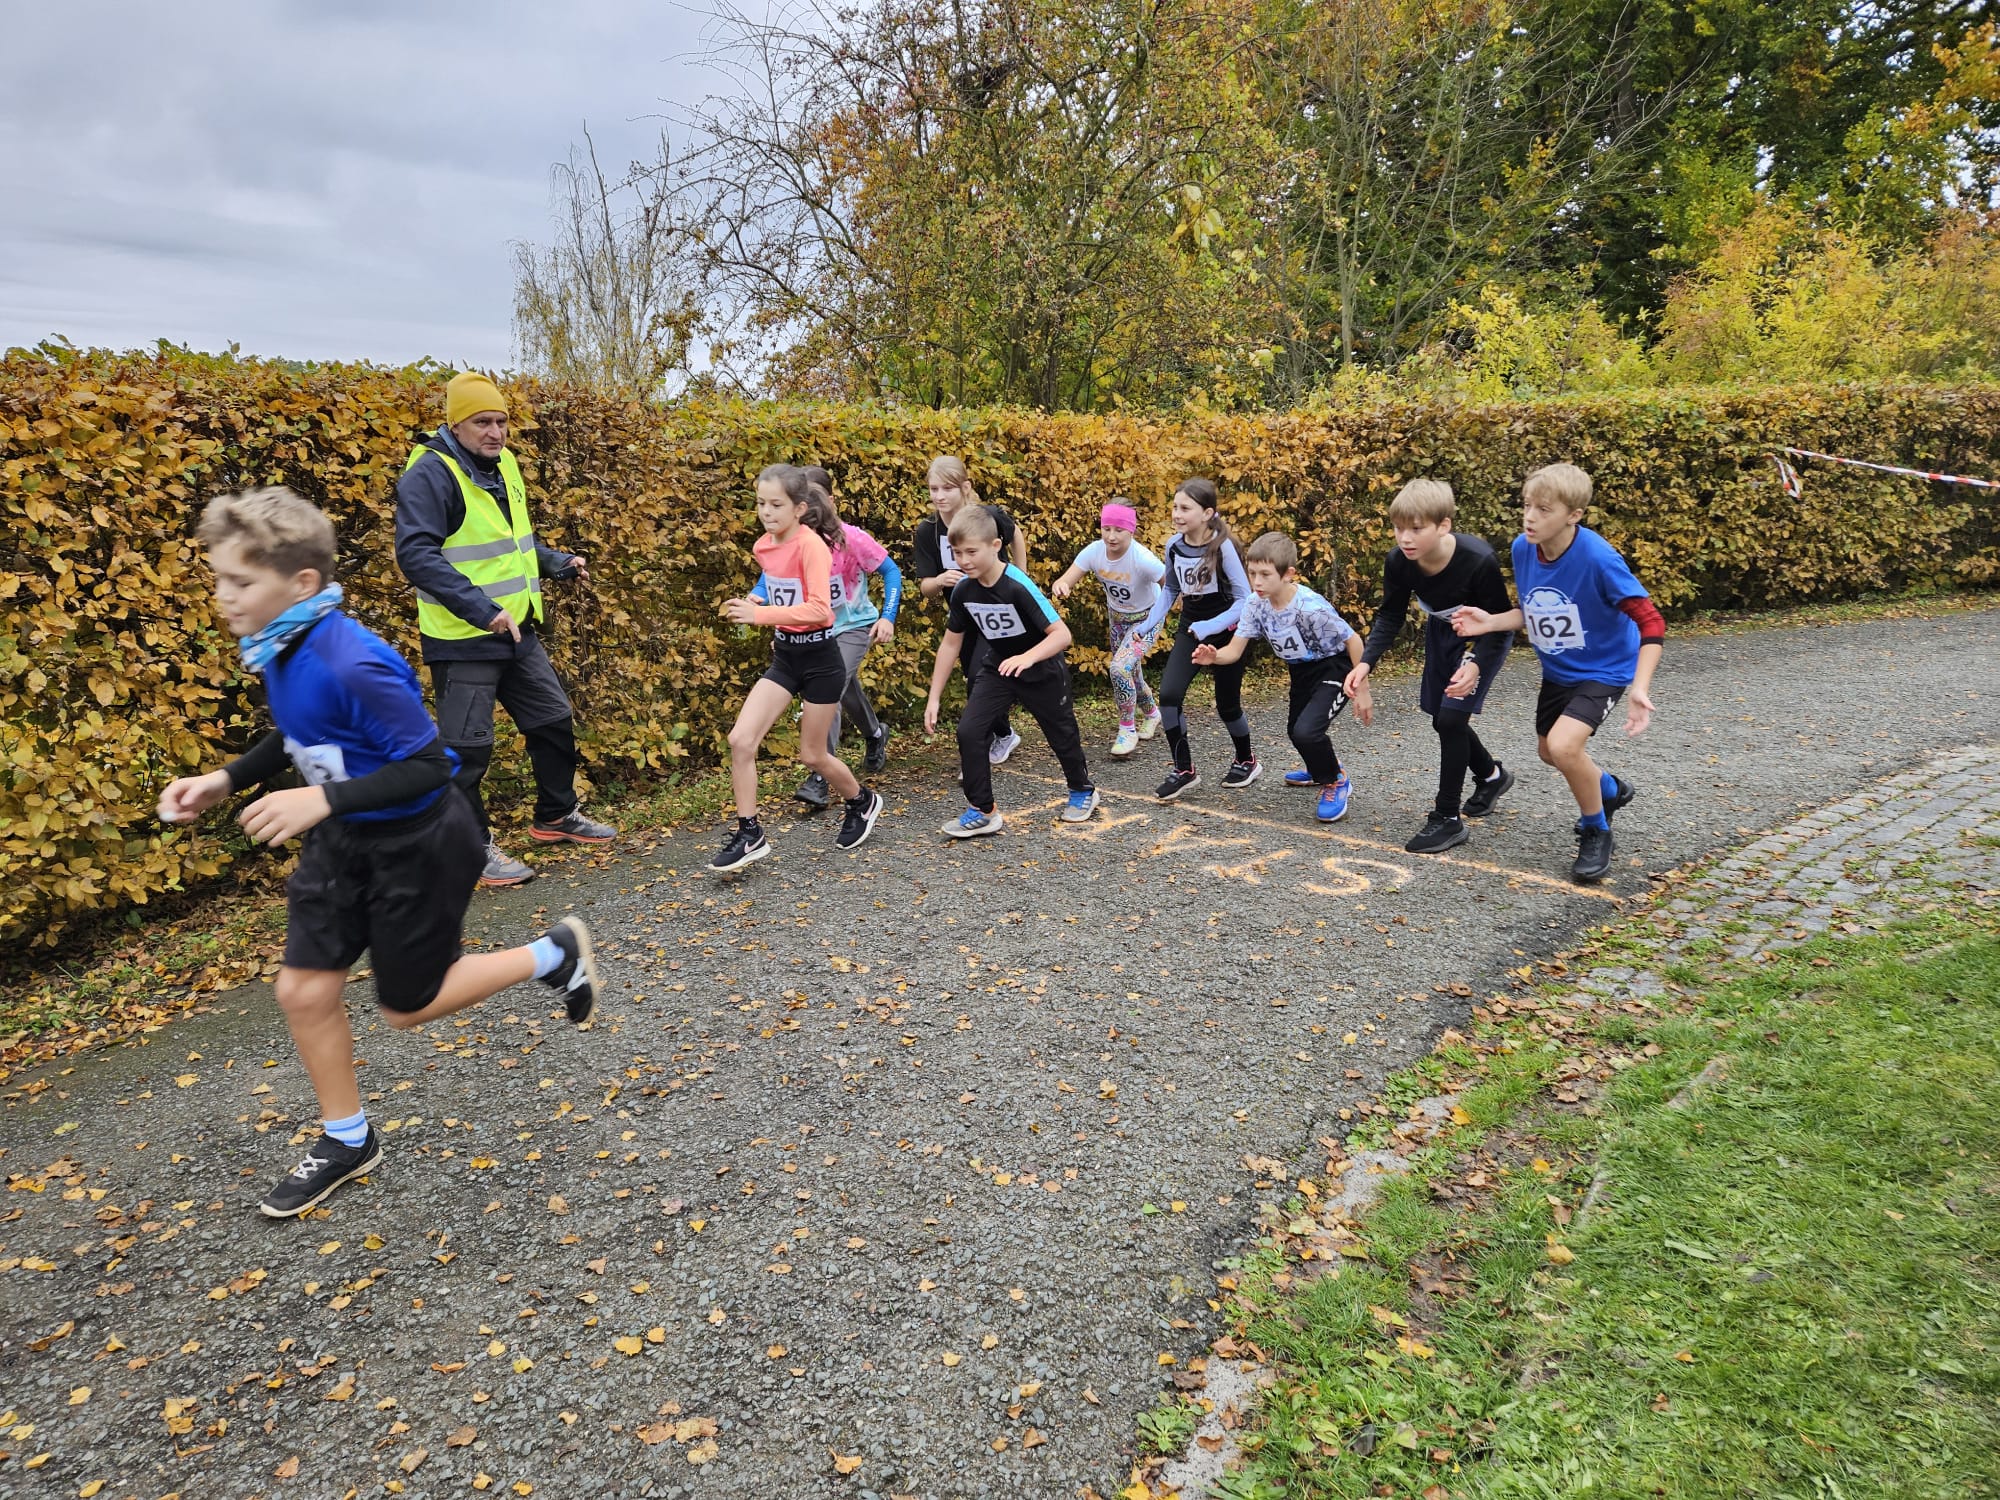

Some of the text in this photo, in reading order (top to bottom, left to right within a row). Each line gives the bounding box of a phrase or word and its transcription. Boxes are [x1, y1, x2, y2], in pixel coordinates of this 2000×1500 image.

[973, 612, 1015, 631] 165
[1528, 615, 1577, 639] 162
[789, 631, 823, 644] NIKE
